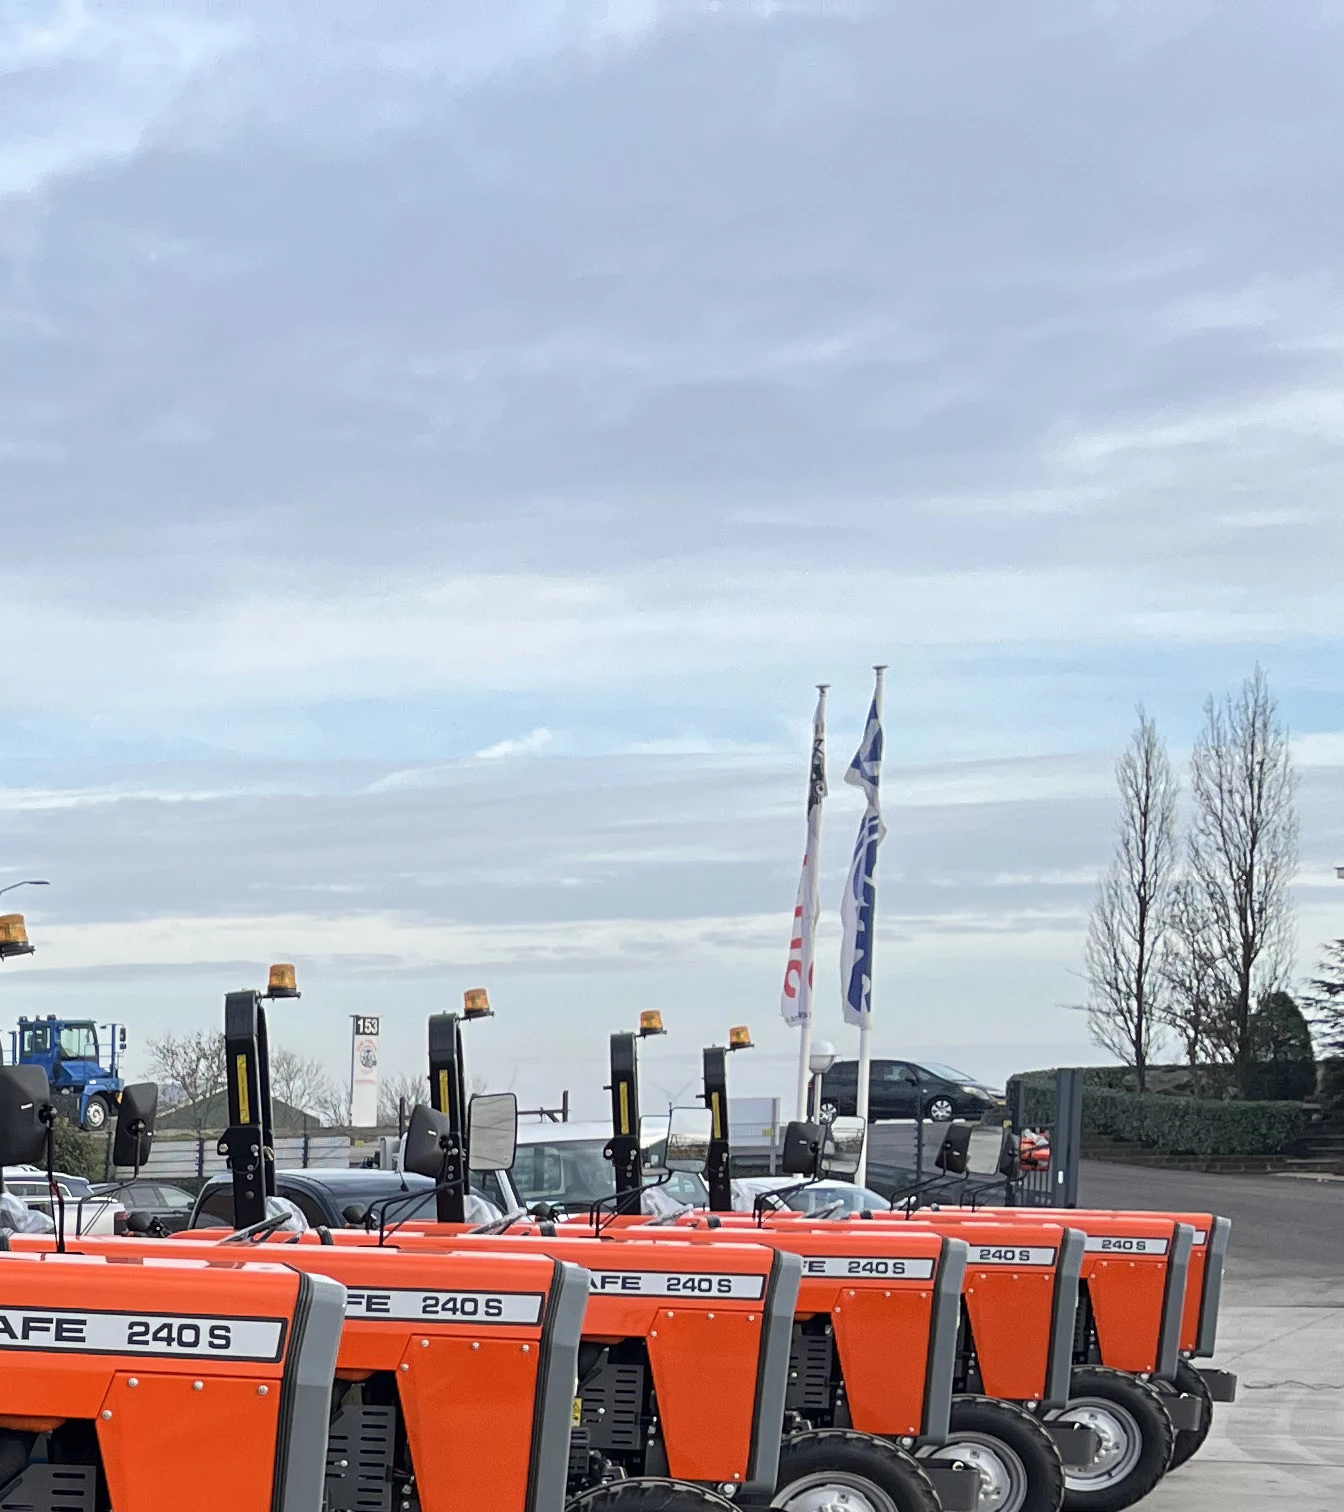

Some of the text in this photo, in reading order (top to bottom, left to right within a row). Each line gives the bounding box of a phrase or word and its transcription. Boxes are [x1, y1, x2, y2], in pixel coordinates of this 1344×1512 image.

[357, 1017, 378, 1034] 153
[590, 1275, 642, 1291] FE
[346, 1293, 391, 1313] FE
